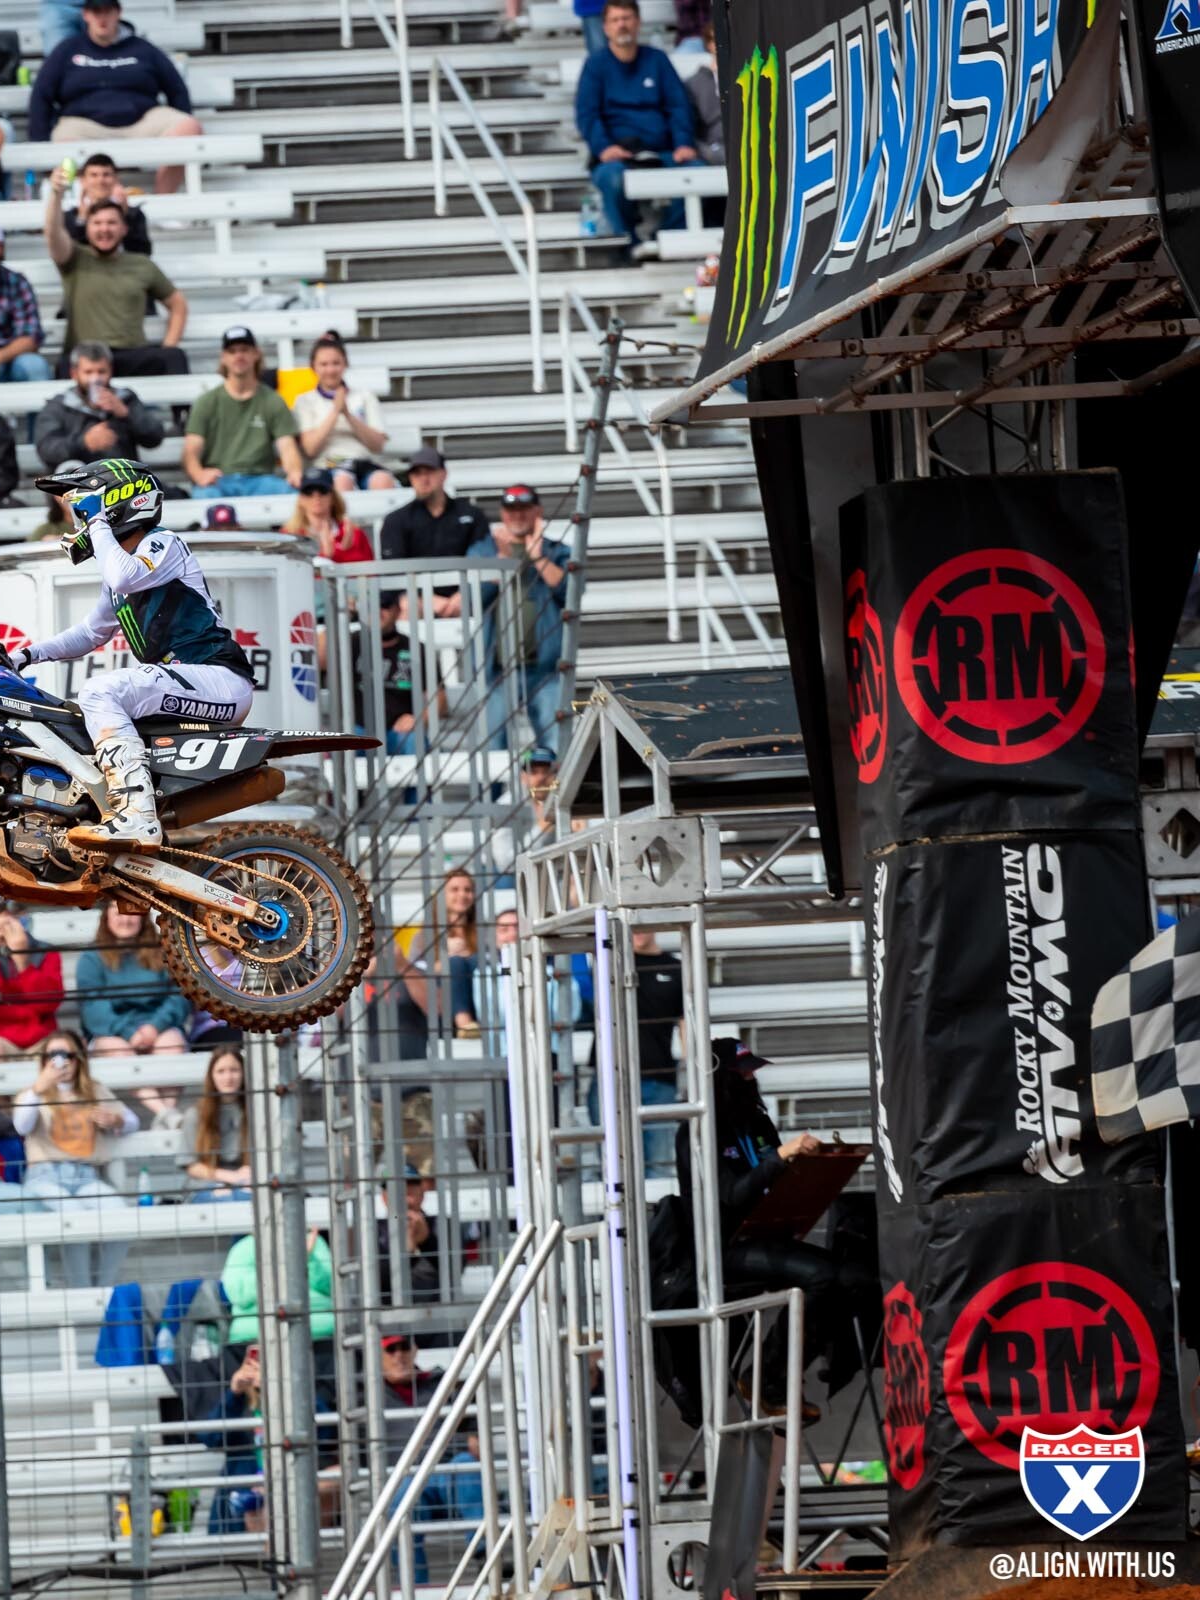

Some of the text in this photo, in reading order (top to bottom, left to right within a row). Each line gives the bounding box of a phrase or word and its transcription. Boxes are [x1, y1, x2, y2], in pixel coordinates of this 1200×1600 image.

[1155, 35, 1194, 55] AMERICAN
[763, 0, 1060, 324] FINISH
[133, 495, 150, 508] BELL
[936, 611, 1066, 702] RM
[0, 697, 32, 713] YAMALUBE
[179, 699, 235, 721] YAMAHA
[179, 722, 210, 732] YAMAHA
[174, 736, 249, 771] 91
[1001, 845, 1044, 1135] ROCKY MOUNTAIN
[980, 1323, 1118, 1418] RM
